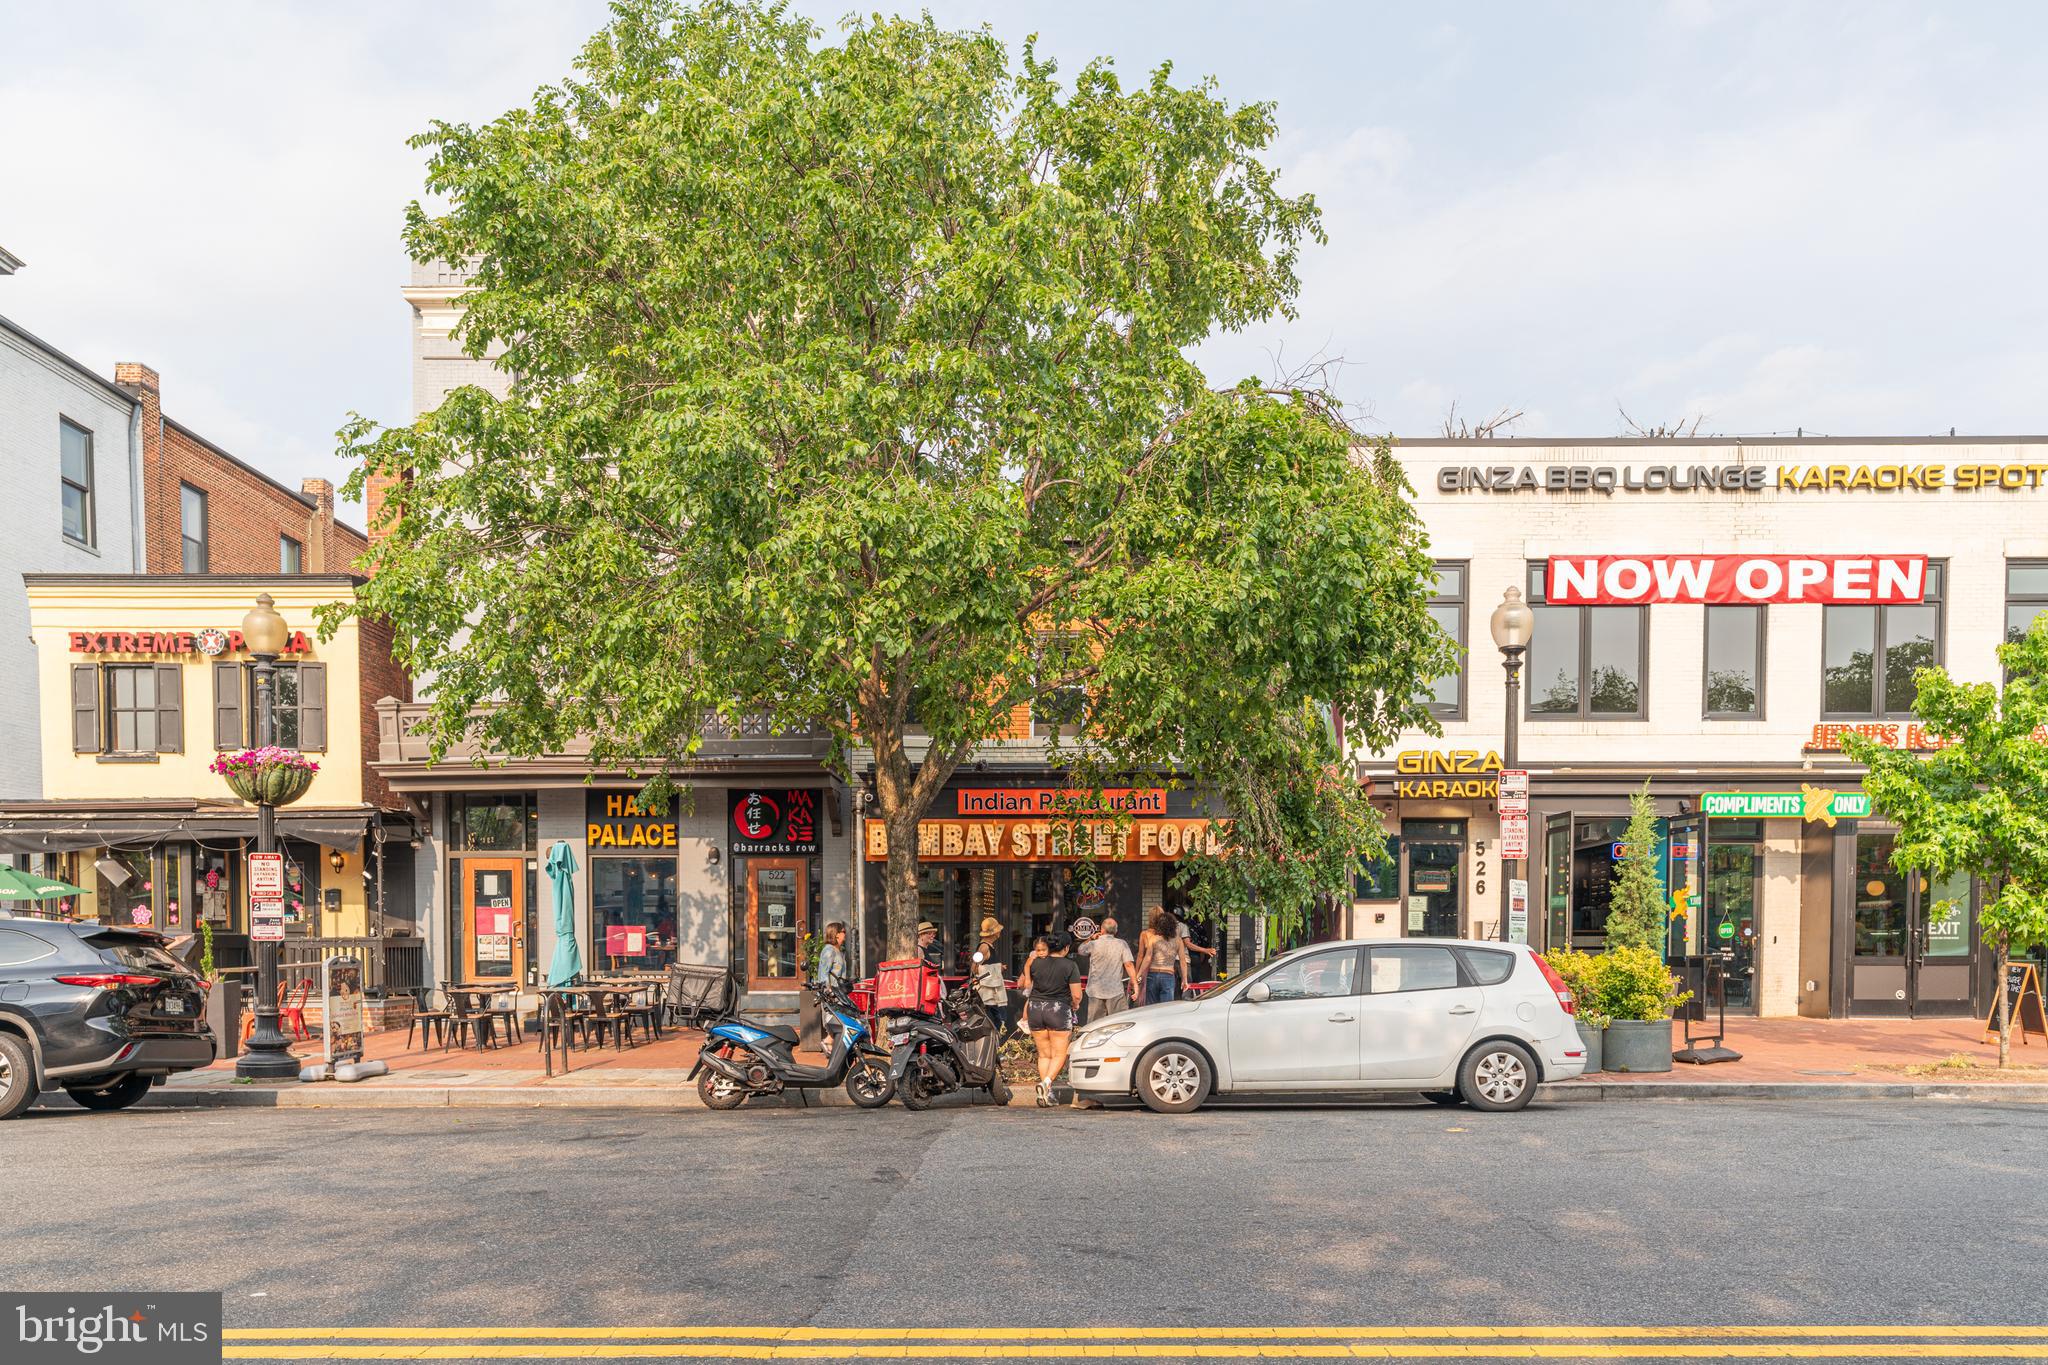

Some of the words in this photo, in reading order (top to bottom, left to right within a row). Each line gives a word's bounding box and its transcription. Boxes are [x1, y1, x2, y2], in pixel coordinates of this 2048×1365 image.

[1438, 466, 1539, 491] GINZA
[1545, 465, 1615, 496] BBQ
[1623, 465, 1766, 491] LOUNGE
[1777, 464, 1946, 490] KARAOKE
[1953, 464, 2048, 490] SPOT
[1552, 559, 1715, 600] NOW
[1734, 559, 1924, 600] OPEN
[68, 631, 195, 653] EXTREME
[1397, 750, 1504, 774] GINZA
[963, 793, 1032, 810] Indian
[1706, 796, 1801, 814] COMPLIMENTS
[1834, 796, 1866, 814] ONLY
[746, 792, 762, 835] お任せ
[588, 823, 677, 846] PALACE
[869, 823, 1005, 856] BMBAY
[768, 870, 786, 880] 522
[492, 898, 509, 907] OPEN
[1928, 922, 1961, 935] EXIT
